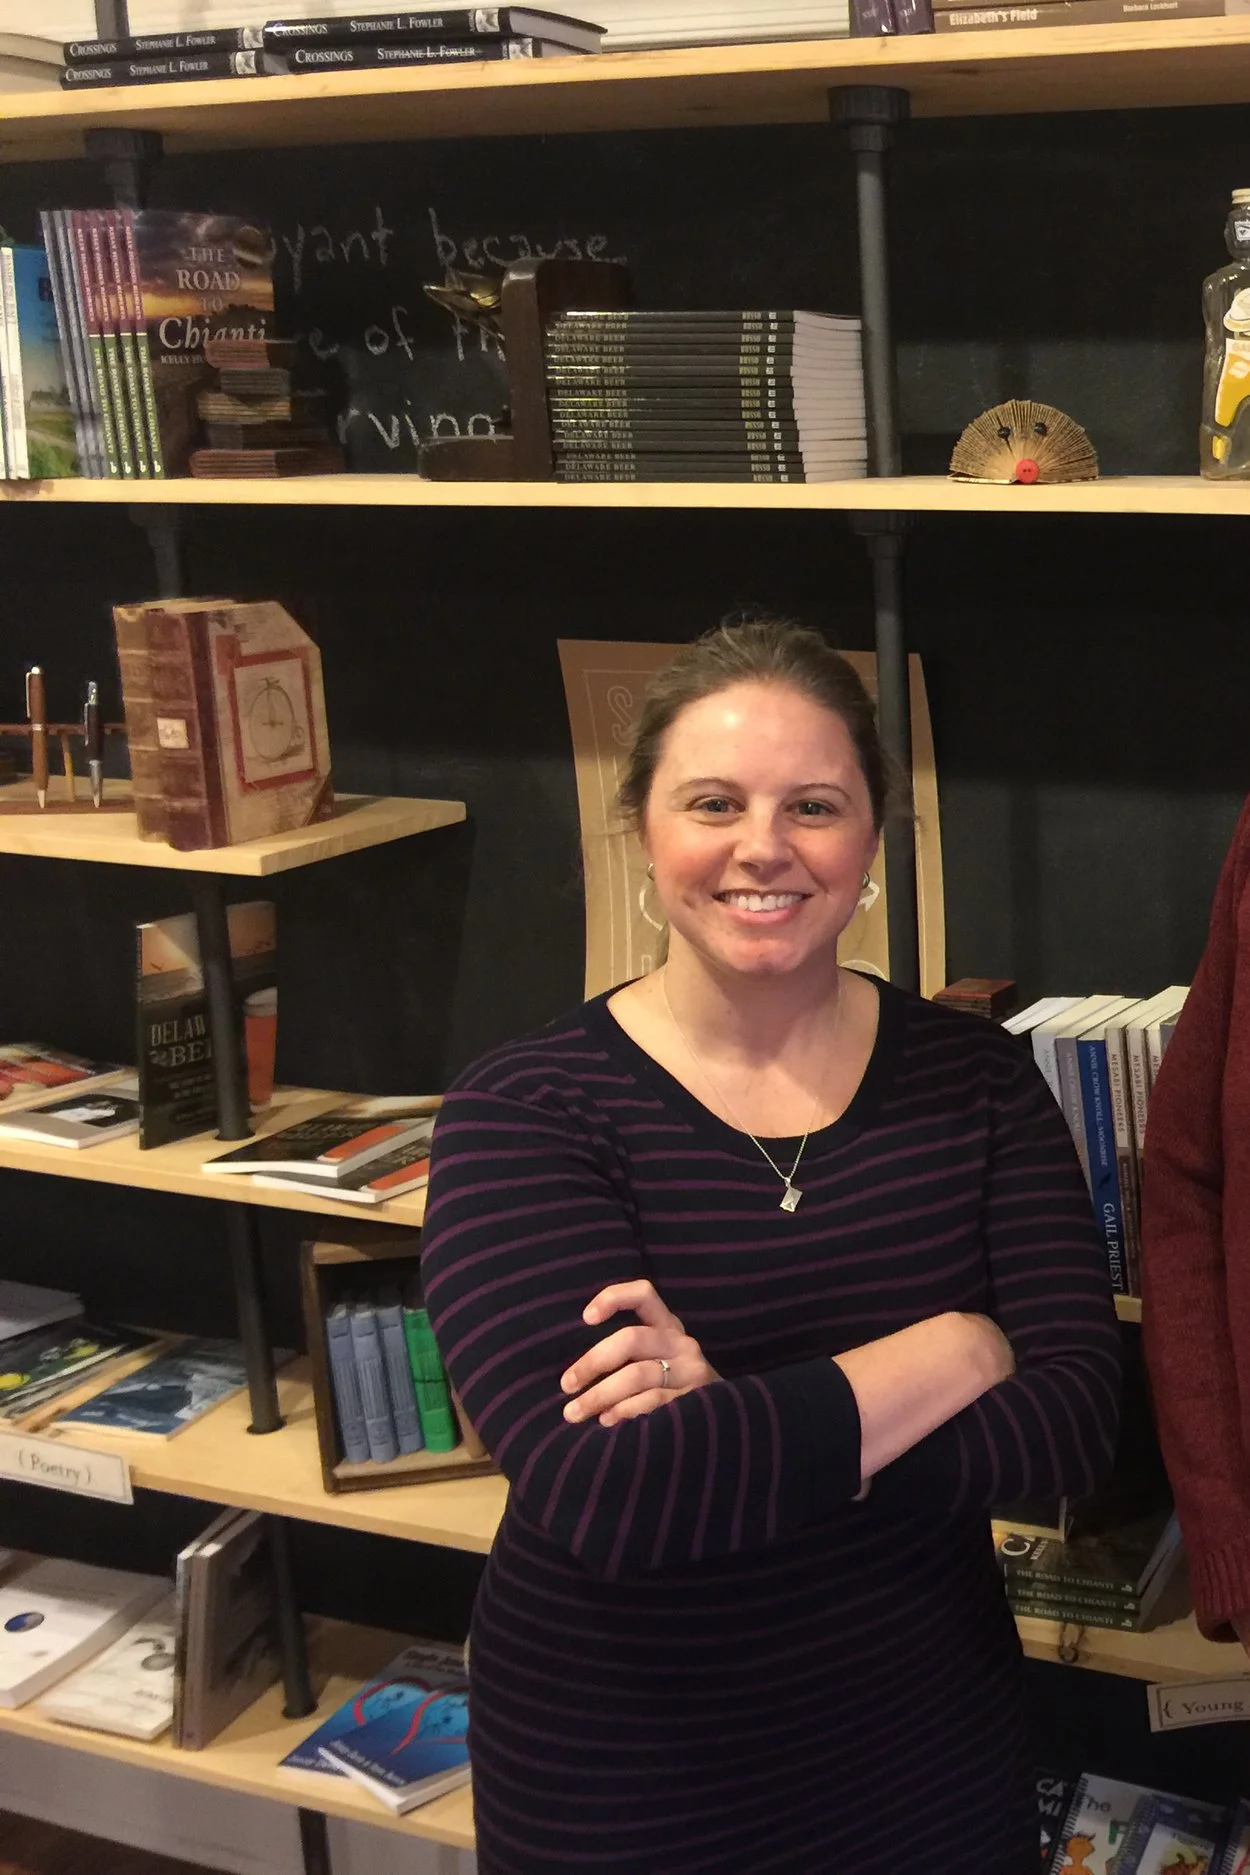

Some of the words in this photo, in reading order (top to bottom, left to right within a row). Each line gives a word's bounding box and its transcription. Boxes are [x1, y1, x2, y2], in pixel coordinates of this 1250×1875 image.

[350, 19, 395, 33] STEPHANIE
[409, 16, 443, 29] FOWLER
[949, 11, 1007, 26] Elizabeth's
[1010, 8, 1038, 21] Field
[70, 42, 117, 57] CROSSINGS
[136, 37, 175, 51] STEPHANIE
[186, 35, 217, 47] FOWLER
[295, 49, 354, 64] CROSSINGS
[377, 47, 424, 60] STEPHANIE
[438, 45, 476, 58] FOWLER
[65, 67, 112, 83] CROSSINGS
[130, 63, 168, 77] STEPHANIE
[179, 60, 209, 72] FOWLER
[189, 246, 225, 263] THE
[176, 269, 240, 291] ROAD
[201, 298, 223, 312] TO
[1111, 1053, 1123, 1088] MESABI
[1133, 1054, 1143, 1089] MESABI
[1115, 1090, 1125, 1133] PIONEERS
[1103, 1202, 1118, 1238] GAIL
[1107, 1241, 1124, 1291] PRIEST
[1181, 1699, 1245, 1715] Young
